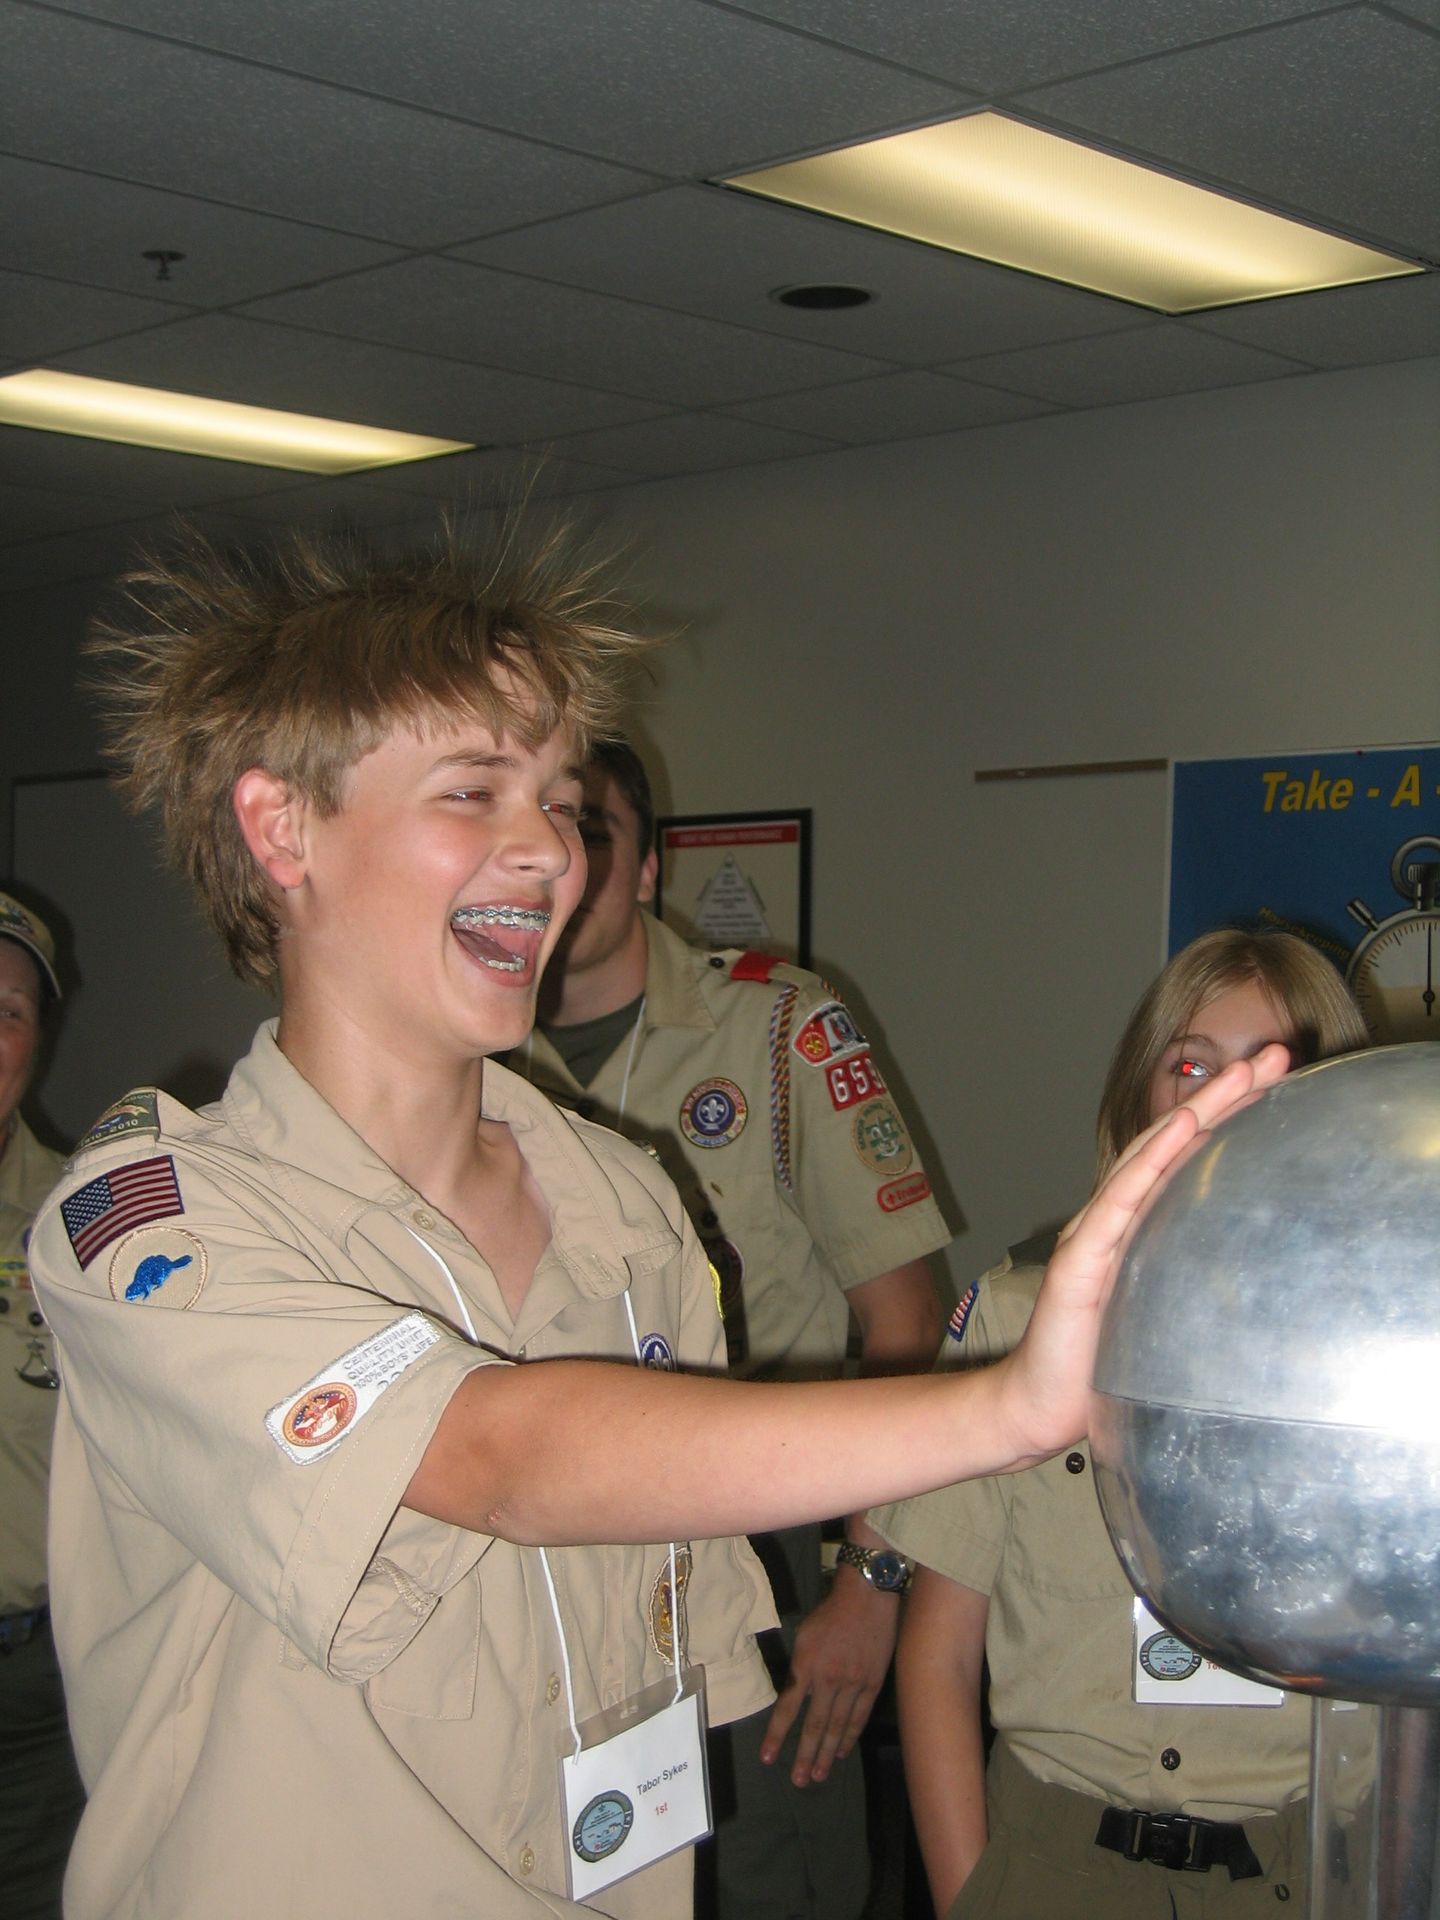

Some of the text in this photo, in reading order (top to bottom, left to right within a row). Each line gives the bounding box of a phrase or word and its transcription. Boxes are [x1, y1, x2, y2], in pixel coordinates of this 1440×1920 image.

[1262, 769, 1354, 813] Take
[1390, 764, 1420, 808] A
[110, 1119, 138, 1133] 2010
[343, 1323, 416, 1370] CENTENNIAL
[347, 1347, 395, 1380] QUALITY
[396, 1328, 425, 1349] UNIT
[414, 1336, 434, 1355] LIFE
[637, 1761, 688, 1795] Tabor Sykes
[655, 1801, 668, 1816] 1st
